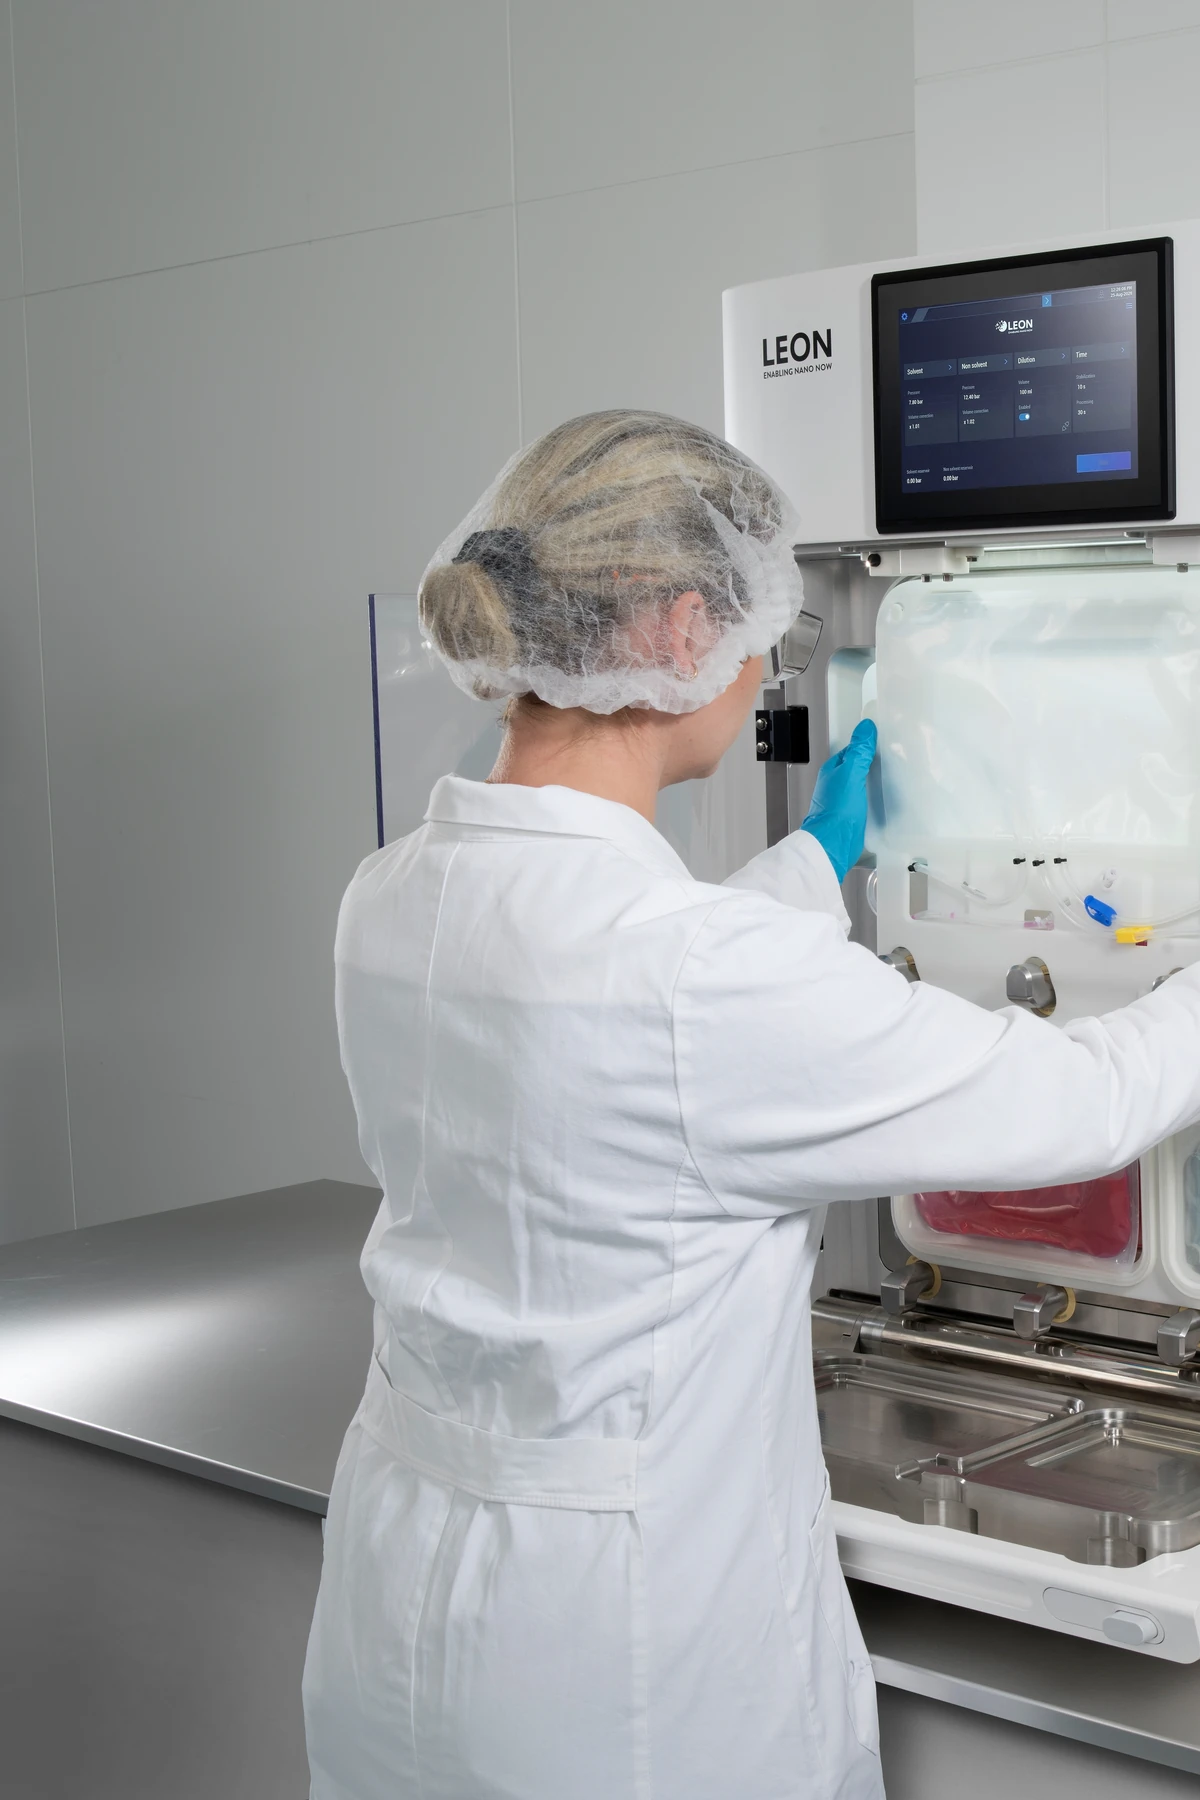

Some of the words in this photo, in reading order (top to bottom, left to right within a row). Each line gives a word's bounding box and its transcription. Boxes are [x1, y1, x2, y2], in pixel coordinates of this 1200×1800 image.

[1008, 319, 1033, 330] LEON
[762, 328, 832, 367] LEON
[1018, 356, 1036, 364] Dilution
[763, 368, 794, 380] ENABLING
[794, 365, 814, 374] NANO
[815, 362, 833, 372] NOW
